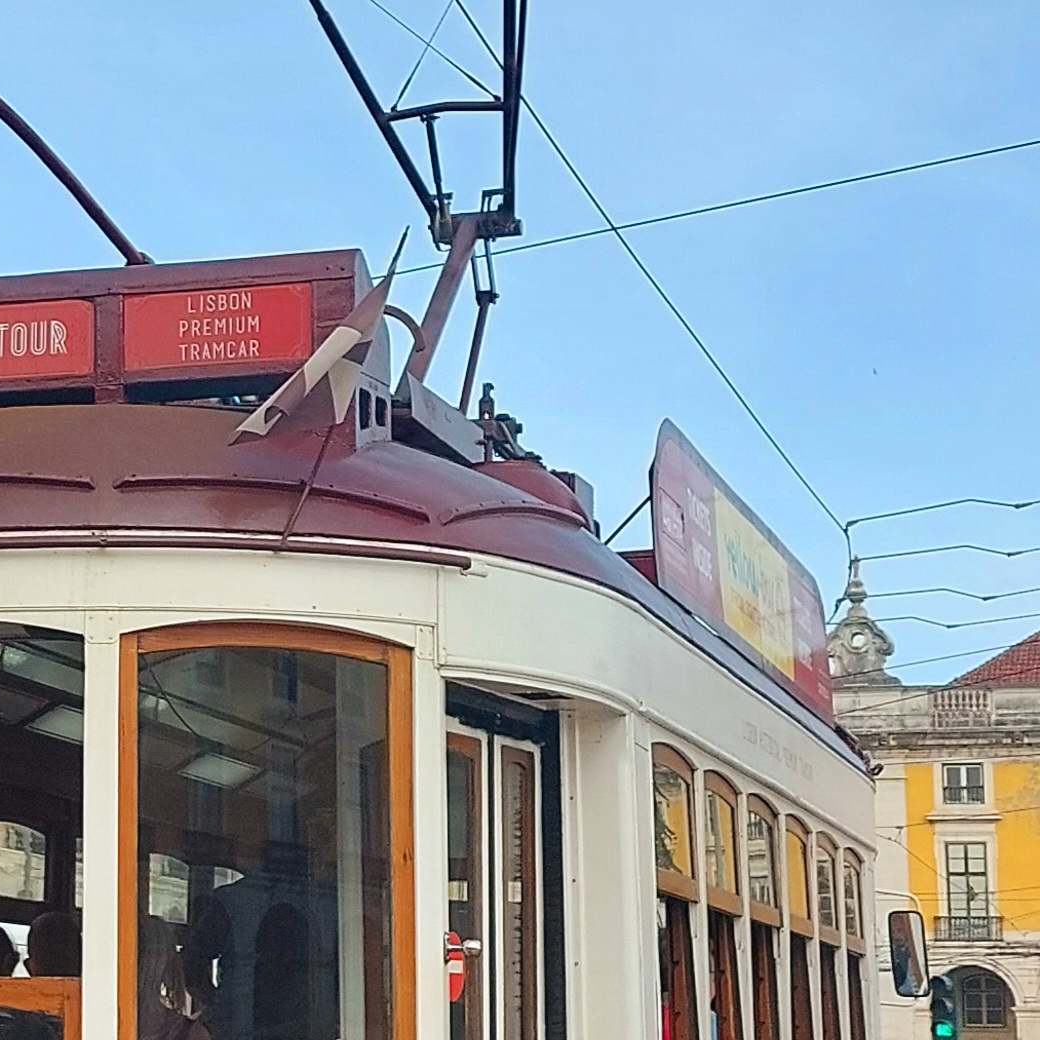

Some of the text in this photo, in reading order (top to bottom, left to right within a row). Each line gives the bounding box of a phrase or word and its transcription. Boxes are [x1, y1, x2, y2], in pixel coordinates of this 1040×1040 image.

[187, 290, 252, 314] LISBON
[179, 315, 260, 338] PREMIUM
[178, 339, 260, 361] TRAMCAR
